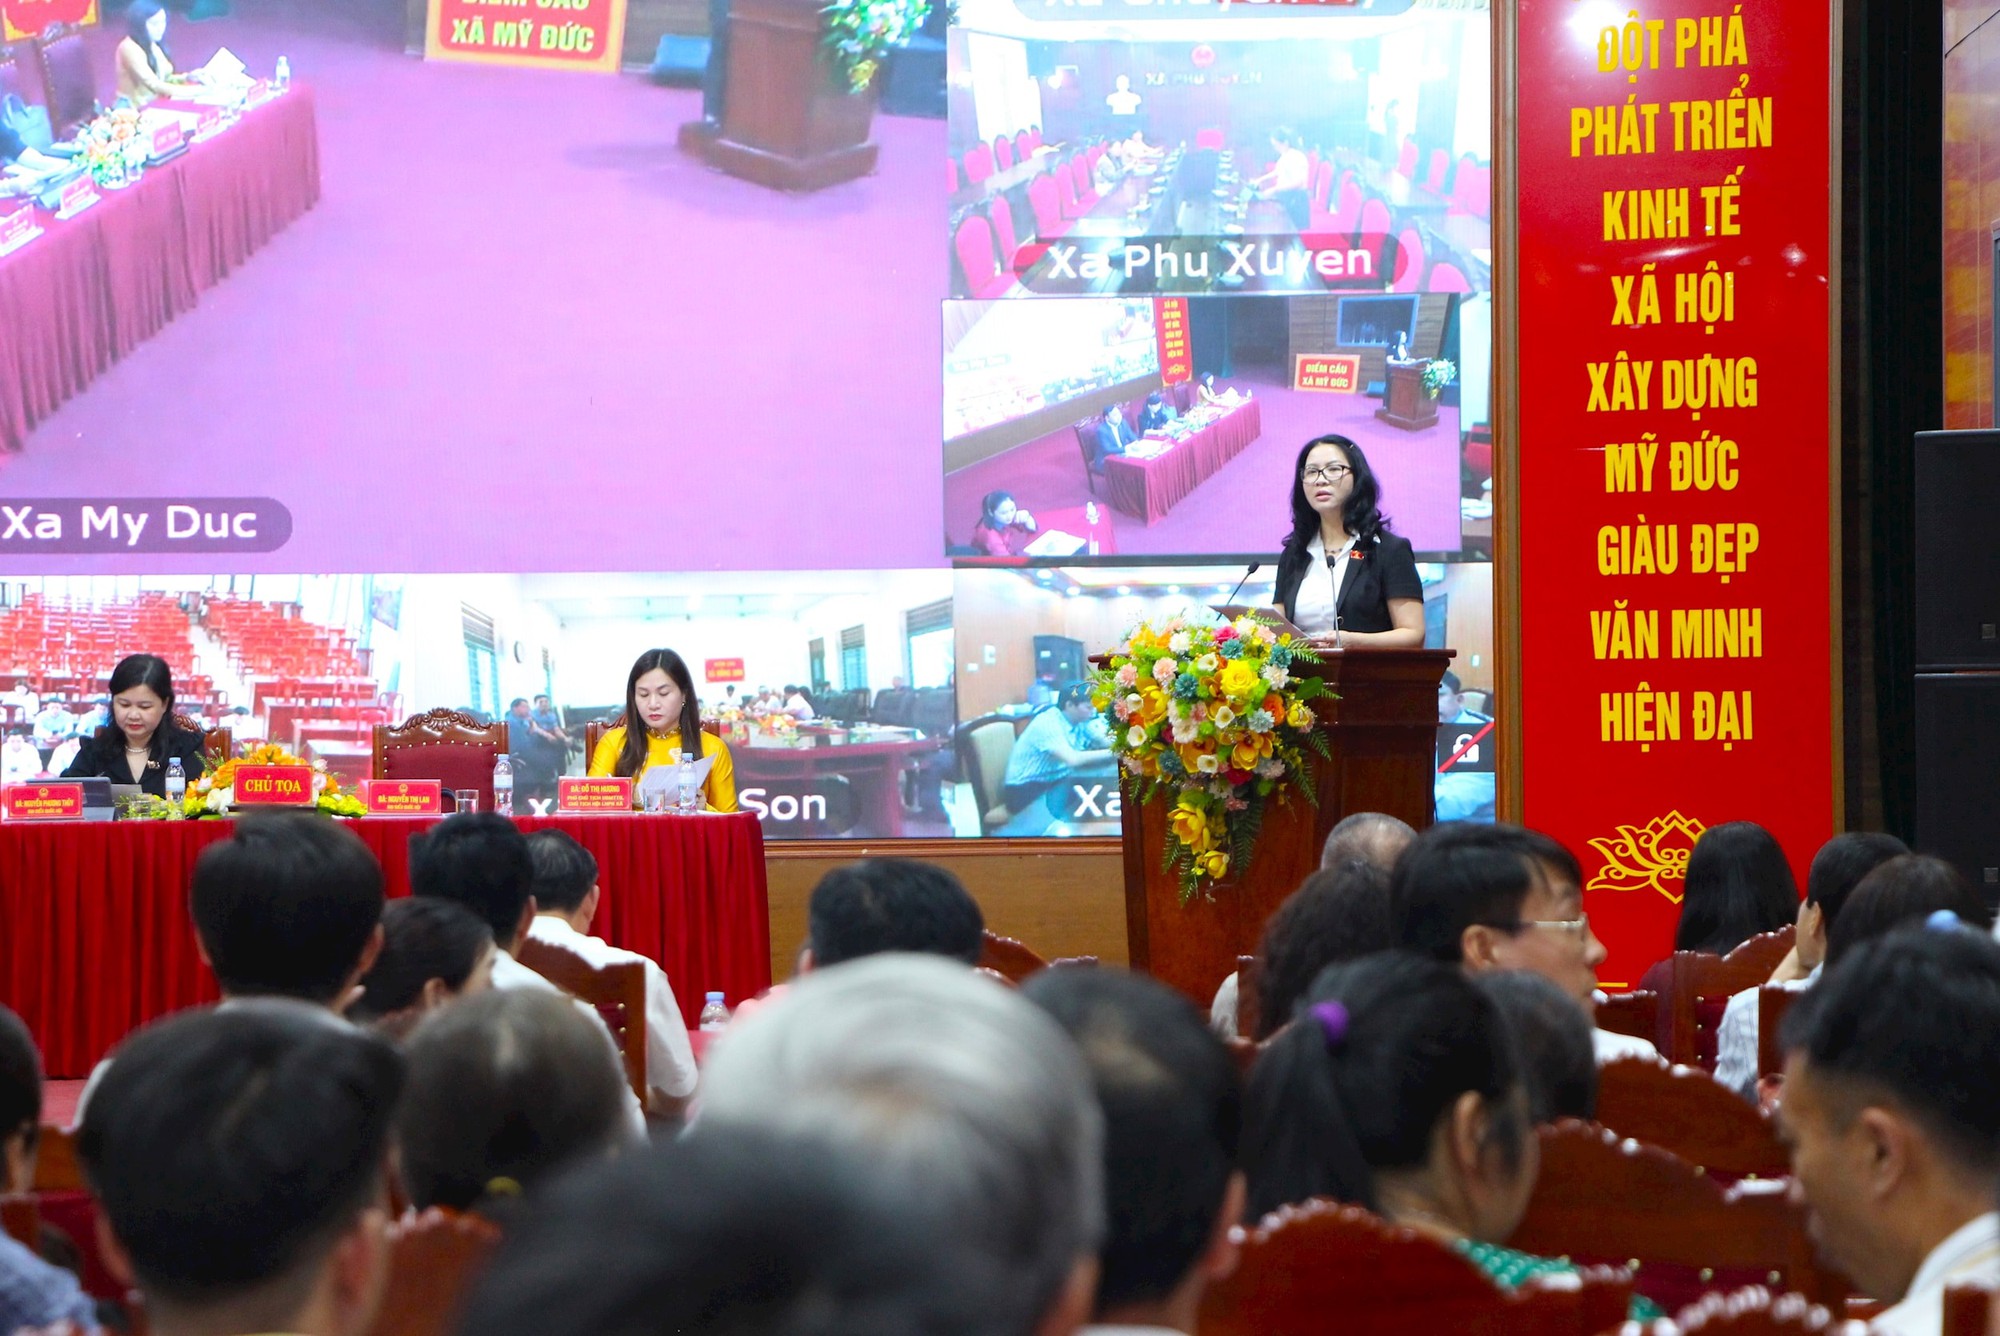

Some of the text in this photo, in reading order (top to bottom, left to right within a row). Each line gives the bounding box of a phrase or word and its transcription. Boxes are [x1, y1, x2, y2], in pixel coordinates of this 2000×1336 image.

[450, 15, 595, 53] XÃ MỸ ĐỨC
[1598, 5, 1748, 84] ĐỘT PHÁ
[1571, 74, 1772, 157] PHÁT TRIỂN
[1604, 165, 1745, 240] KINH TẾ
[1048, 243, 1372, 283] Xa Phu Xuyen
[1612, 261, 1734, 334] XÃ HỘI
[1587, 351, 1758, 421] XÂY DỰNG
[1604, 431, 1739, 492] MỸ ĐỨC
[2, 505, 257, 546] Xa My Duc
[1598, 514, 1759, 583] GIÀU ĐẸP
[1591, 599, 1762, 660] VĂN MINH
[1601, 682, 1753, 752] HIỆN ĐẠI
[246, 775, 301, 796] CHỦ TỌA
[738, 787, 827, 821] Son
[1073, 784, 1121, 817] Xa
